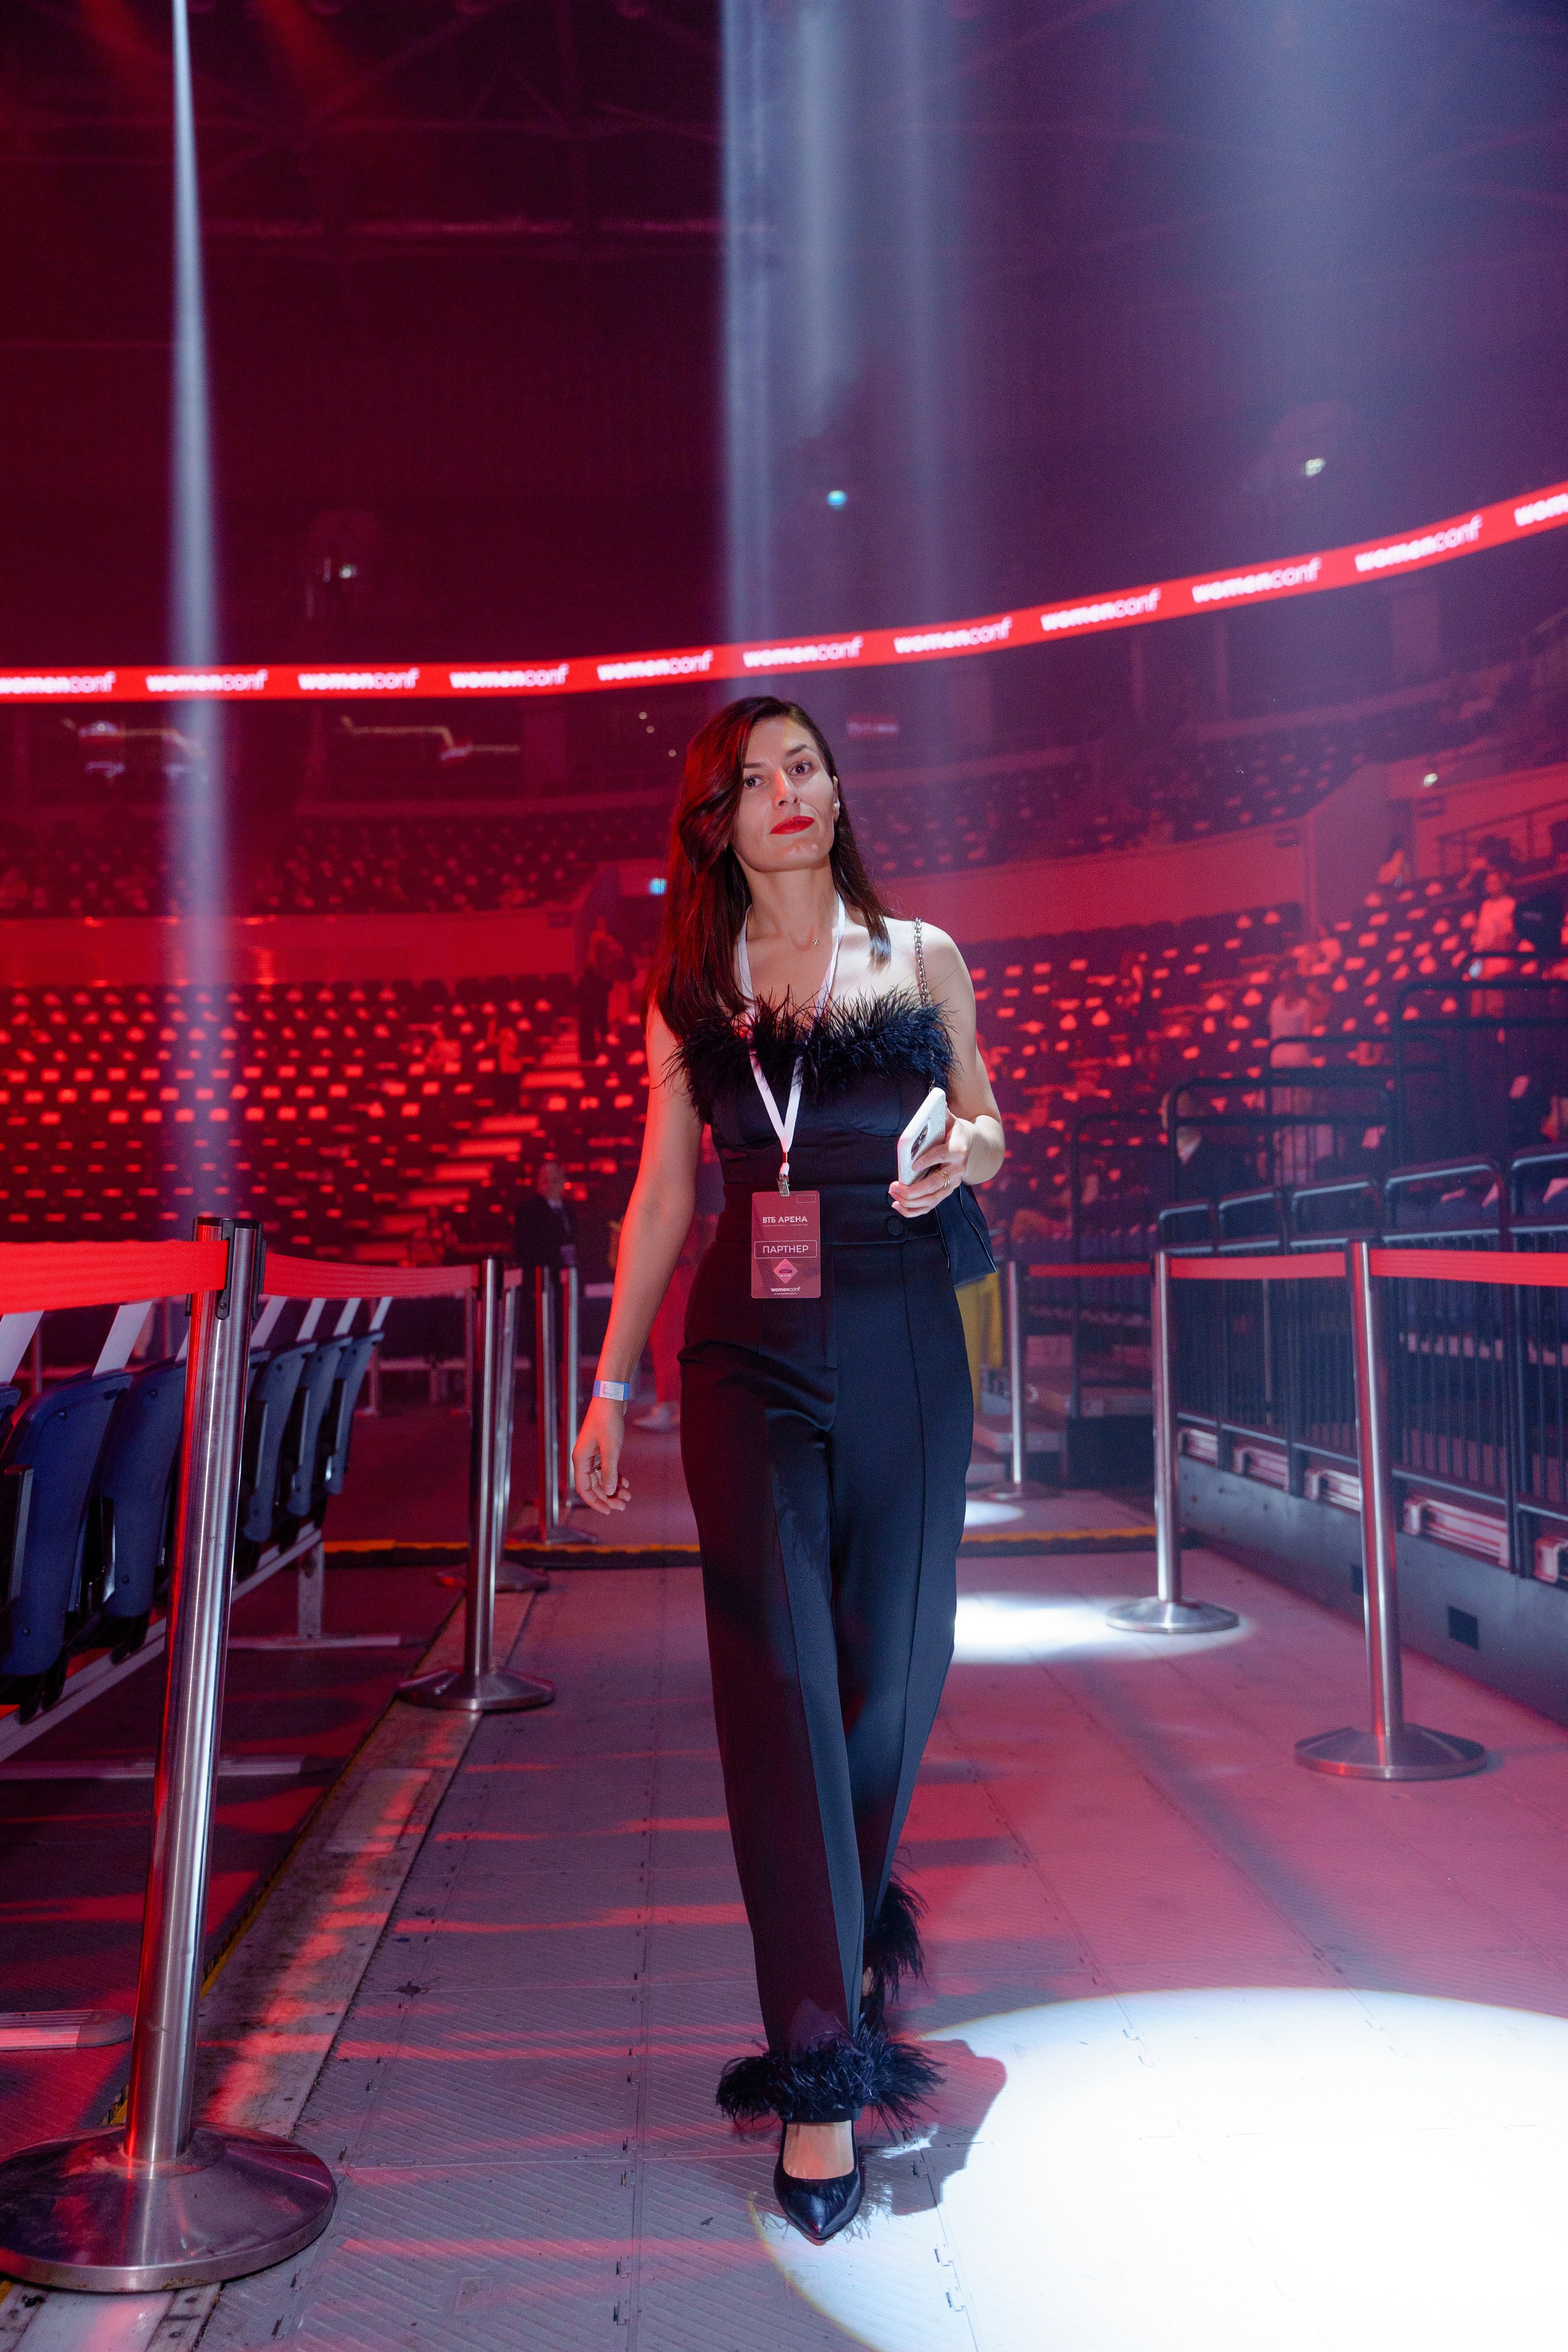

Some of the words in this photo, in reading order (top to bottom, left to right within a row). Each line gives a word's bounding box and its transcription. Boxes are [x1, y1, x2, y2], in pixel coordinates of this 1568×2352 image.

[146, 670, 267, 692] womenconf
[298, 668, 419, 690] womenconf
[450, 665, 568, 688] womenconf
[597, 650, 713, 681] womenconf
[742, 636, 862, 668] womenconf
[893, 617, 1012, 654] womenconf
[1040, 588, 1160, 631] womenconf
[1191, 557, 1321, 603] womenconf
[1354, 514, 1482, 572] womenconf
[763, 1245, 809, 1254] ПАРТНЕР
